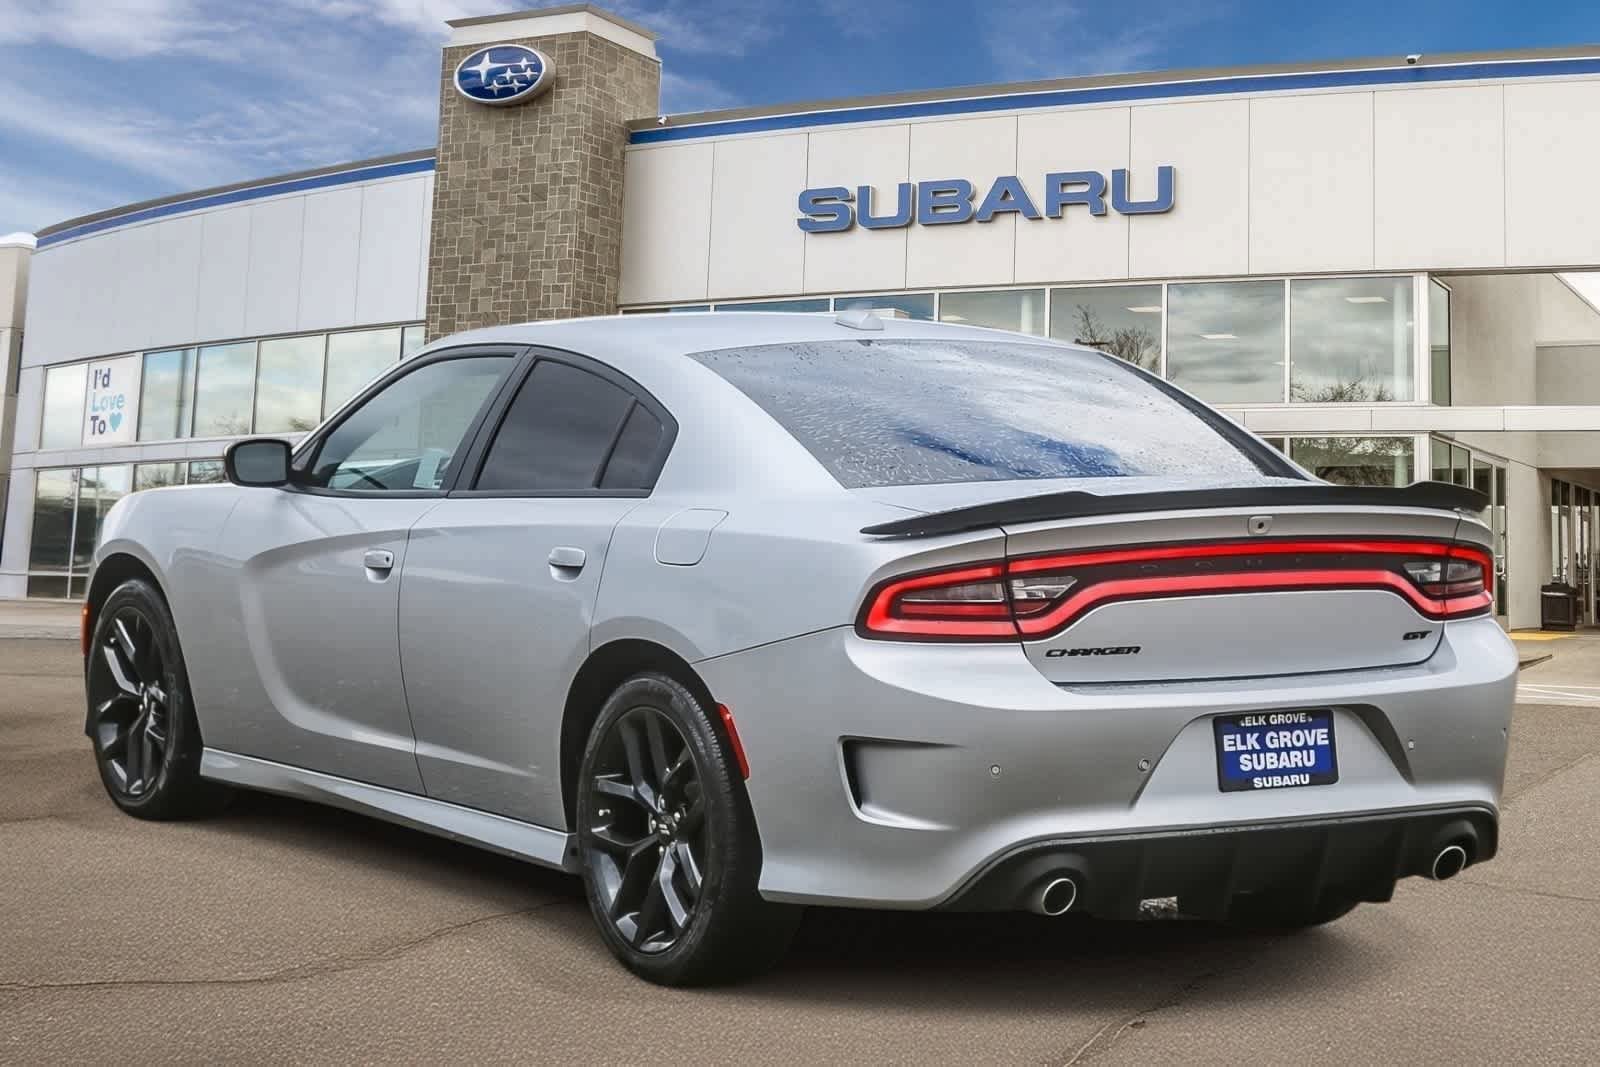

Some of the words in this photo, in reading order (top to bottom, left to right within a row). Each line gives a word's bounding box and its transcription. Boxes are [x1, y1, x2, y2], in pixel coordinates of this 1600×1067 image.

[797, 165, 1177, 234] SUBARU
[94, 367, 112, 390] I'd
[91, 392, 125, 412] Love
[90, 415, 106, 435] To
[1402, 630, 1433, 641] GT
[1045, 646, 1142, 657] CHARGER
[1223, 733, 1261, 752] ELK
[1265, 728, 1329, 749] GROVE
[1239, 749, 1315, 772] SUBARU
[1253, 773, 1310, 788] SUBARU
